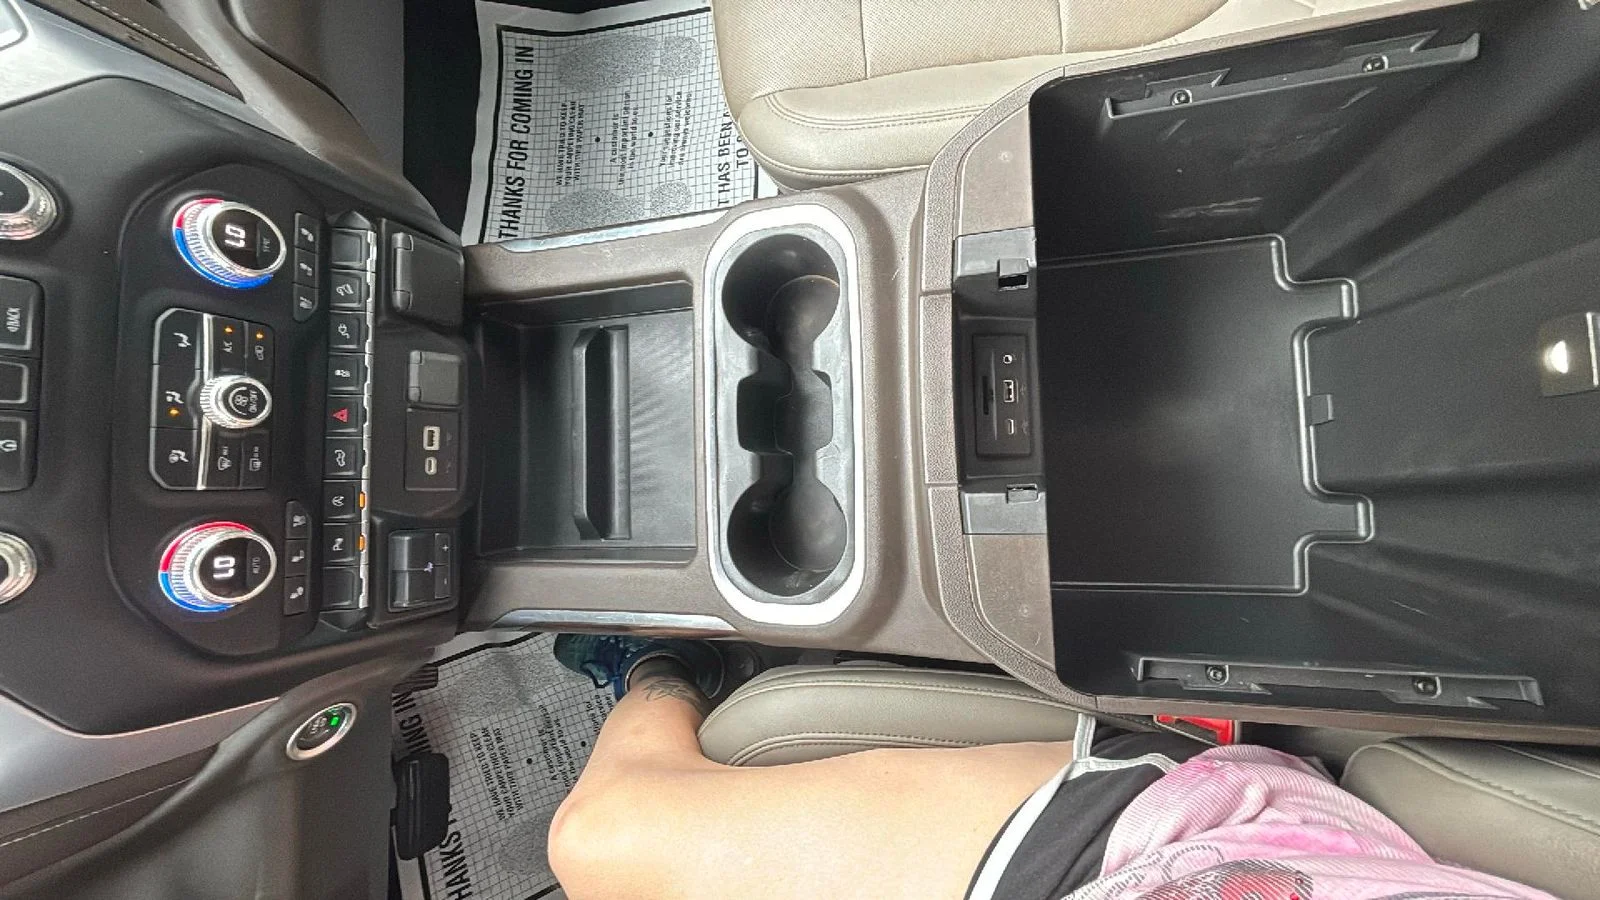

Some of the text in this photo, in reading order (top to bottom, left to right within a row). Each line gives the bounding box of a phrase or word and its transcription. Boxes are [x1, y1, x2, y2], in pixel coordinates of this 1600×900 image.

[559, 121, 567, 131] TO
[620, 116, 630, 152] important
[629, 126, 637, 147] world
[498, 45, 534, 239] THANKS FOR COMING IN
[611, 122, 619, 156] customer
[718, 121, 733, 157] BEEN
[736, 148, 749, 169] TO
[717, 162, 731, 194] HAS
[718, 199, 730, 207] T
[224, 224, 246, 248] LO
[6, 307, 21, 327] BACK
[223, 341, 233, 353] A/C
[249, 389, 259, 413] ON/OFF
[212, 556, 235, 579] LO
[391, 689, 432, 753] ING IN
[476, 751, 486, 763] TO
[498, 744, 511, 769] PAPER
[540, 738, 555, 774] customer
[547, 729, 565, 767] important
[558, 739, 572, 761] world
[481, 763, 494, 786] TRIED
[488, 786, 502, 808] HAVE
[503, 796, 515, 817] YOUR
[512, 789, 524, 811] WITH
[496, 809, 506, 821] WE
[439, 831, 473, 900] HANKS
